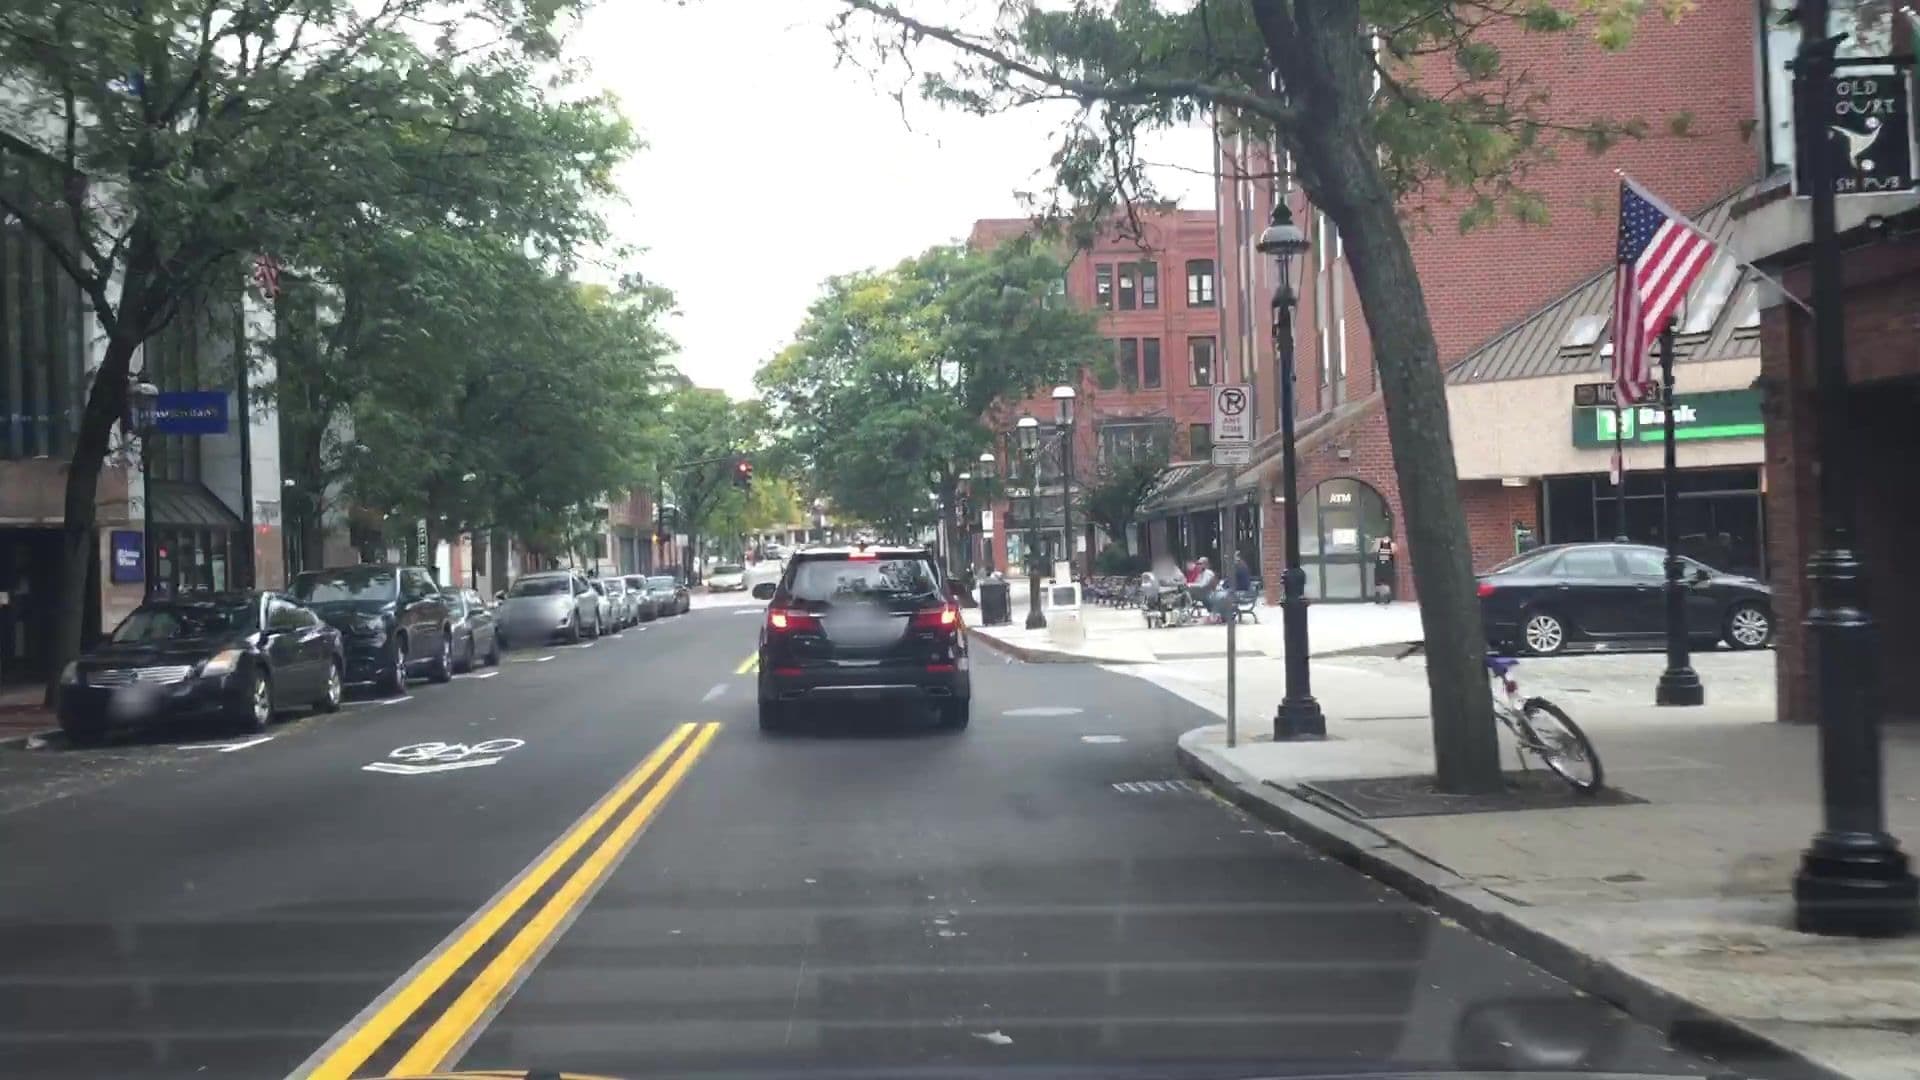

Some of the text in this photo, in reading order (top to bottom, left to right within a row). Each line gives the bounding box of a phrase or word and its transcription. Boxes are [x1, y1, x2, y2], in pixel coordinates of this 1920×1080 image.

[1836, 80, 1878, 96] OLD
[1834, 97, 1896, 115] OURT
[1863, 176, 1899, 192] PUB
[1639, 405, 1697, 425] Bank
[1329, 493, 1351, 504] ATM
